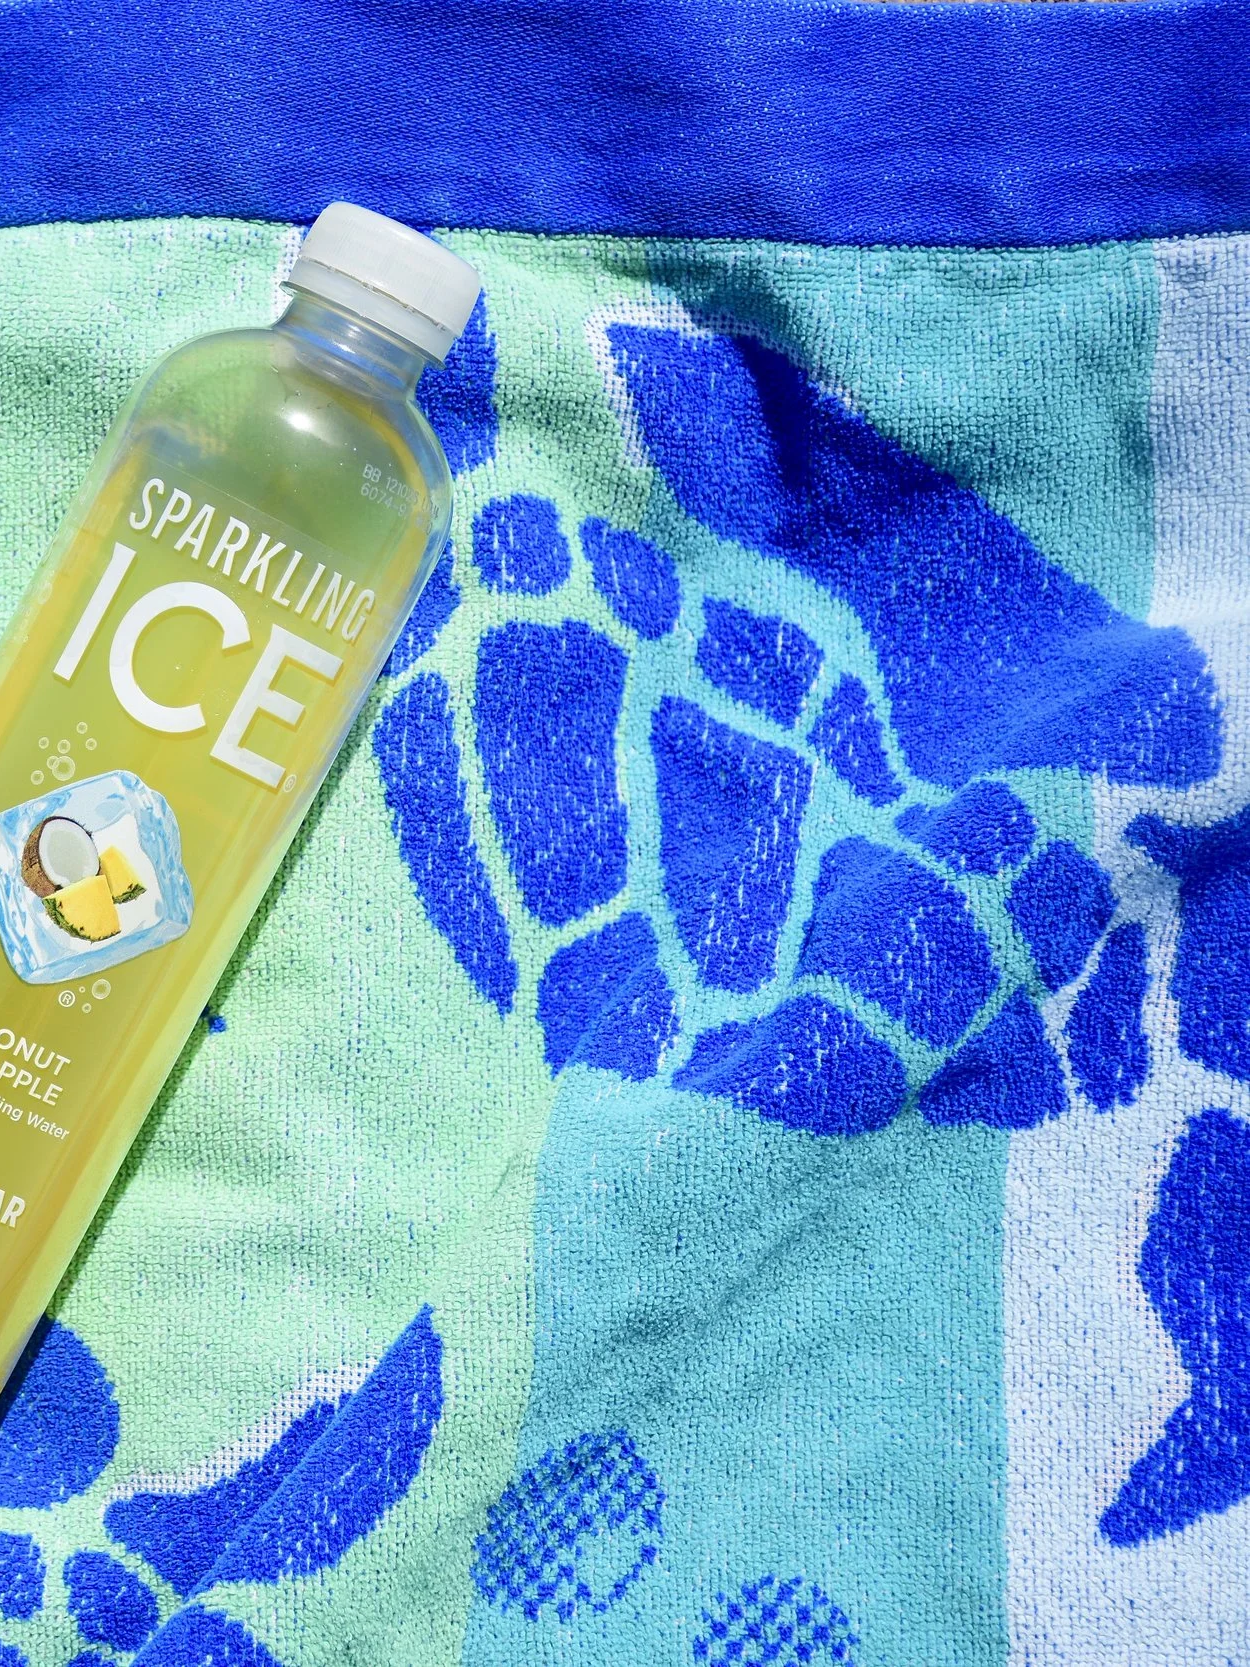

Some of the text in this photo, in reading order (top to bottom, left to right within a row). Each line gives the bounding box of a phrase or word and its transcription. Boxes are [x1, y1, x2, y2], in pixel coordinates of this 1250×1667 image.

[361, 463, 382, 483] BB
[129, 477, 376, 641] SPARKLING
[53, 541, 344, 788] ICE
[26, 1111, 71, 1141] Water
